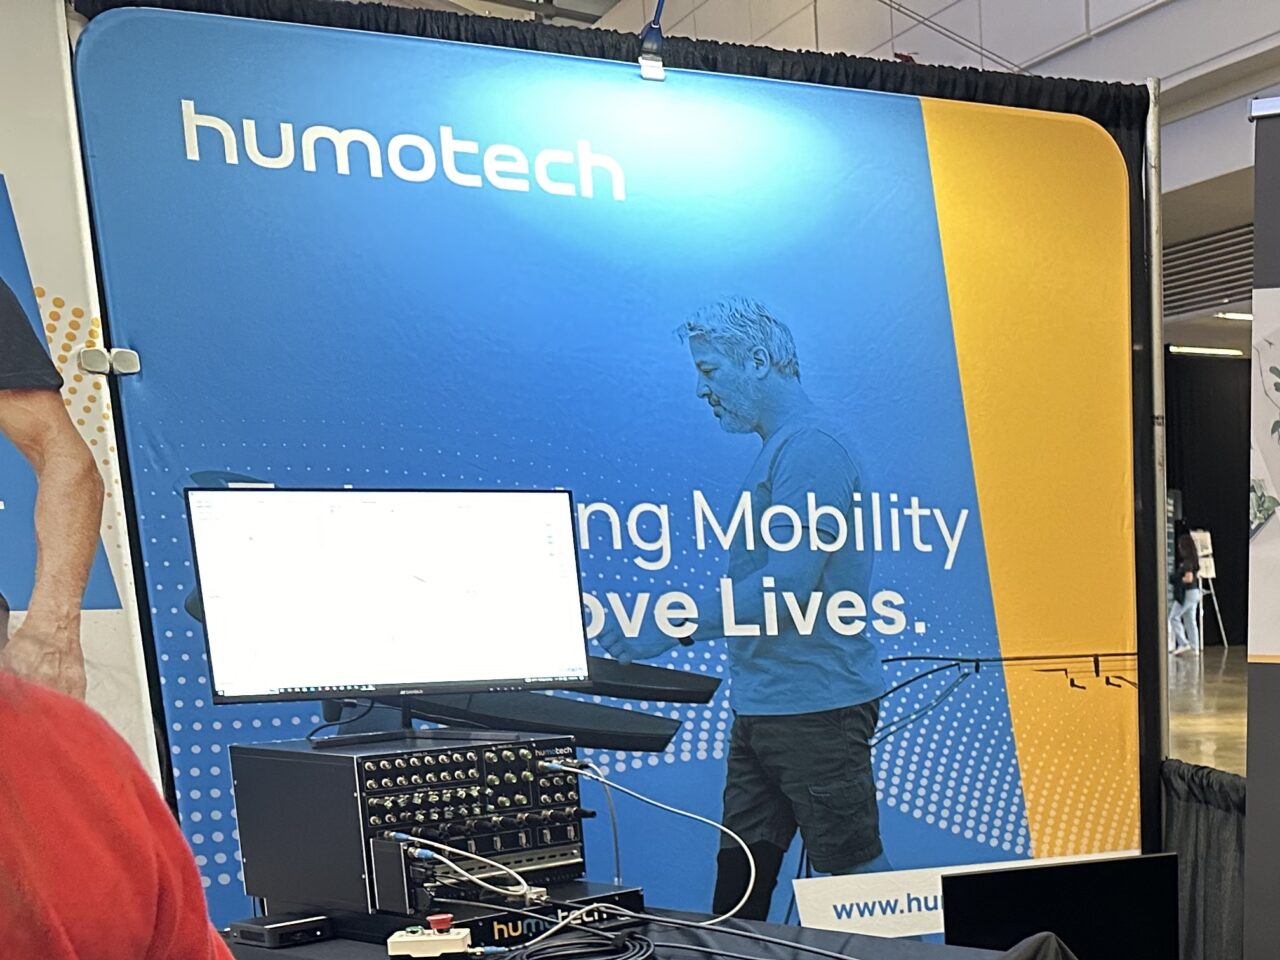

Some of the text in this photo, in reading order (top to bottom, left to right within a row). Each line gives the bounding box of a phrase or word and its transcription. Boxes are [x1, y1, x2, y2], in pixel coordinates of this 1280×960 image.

[180, 99, 626, 201] humotech
[692, 489, 969, 571] Mobility
[720, 576, 927, 637] Lives.
[832, 893, 944, 920] www.hu
